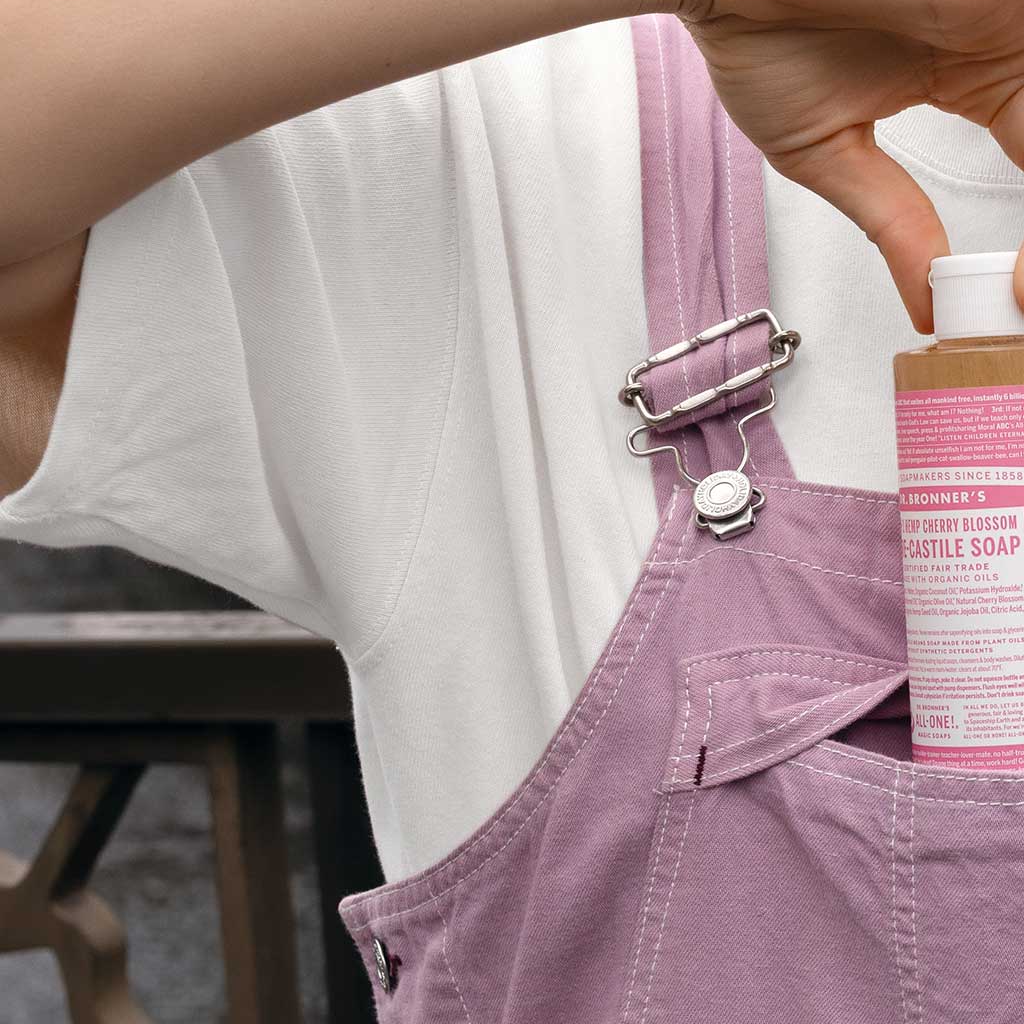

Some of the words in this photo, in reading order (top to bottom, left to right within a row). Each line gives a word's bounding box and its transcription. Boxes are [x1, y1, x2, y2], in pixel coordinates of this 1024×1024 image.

[932, 395, 957, 404] mankind
[973, 393, 1003, 402] instantly
[957, 407, 984, 415] Nothing!
[978, 424, 996, 432] Moral
[964, 432, 998, 440] CHILDREN
[954, 470, 992, 480] SINCE
[995, 471, 1024, 480] 1858
[922, 518, 958, 534] CHERRY
[962, 515, 1017, 532] BLOSSOM
[971, 536, 1020, 558] SOAP
[932, 564, 950, 572] FAIR
[954, 562, 990, 572] TRADE
[928, 575, 970, 584] ORGANIC
[974, 574, 999, 582] OILS
[960, 586, 990, 594] Potassium
[977, 596, 998, 606] Cherry
[998, 595, 1024, 604] Blossom
[939, 608, 959, 617] Organic
[960, 607, 979, 616] Jojoba
[980, 606, 990, 615] Oil,
[991, 606, 1008, 614] Citric
[1009, 605, 1024, 613] Acid,
[999, 758, 1018, 766] hard!
